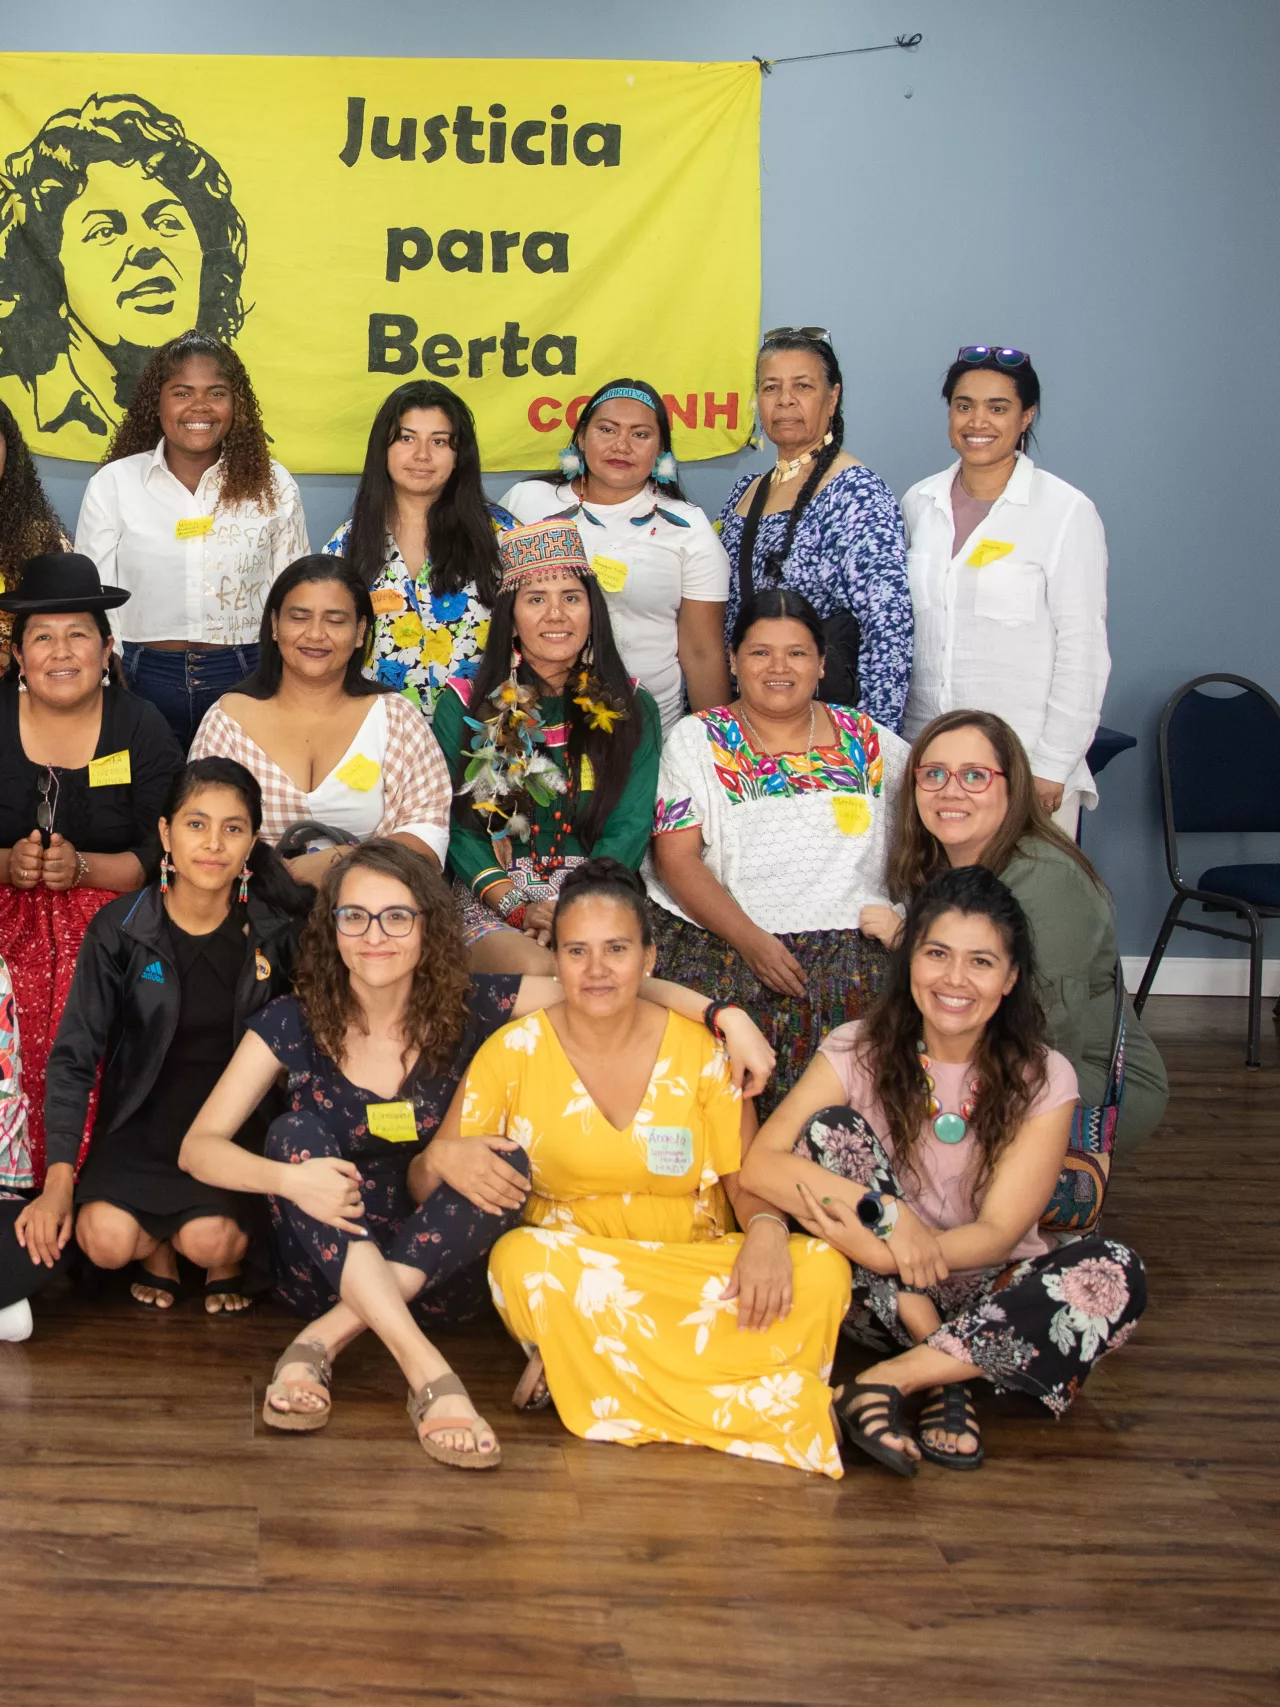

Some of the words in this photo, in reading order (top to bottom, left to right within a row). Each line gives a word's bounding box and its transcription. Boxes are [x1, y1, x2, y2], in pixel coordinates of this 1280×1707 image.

[339, 97, 621, 168] Justicia
[386, 226, 569, 282] para
[368, 313, 578, 378] Berta
[527, 392, 738, 433] CONH
